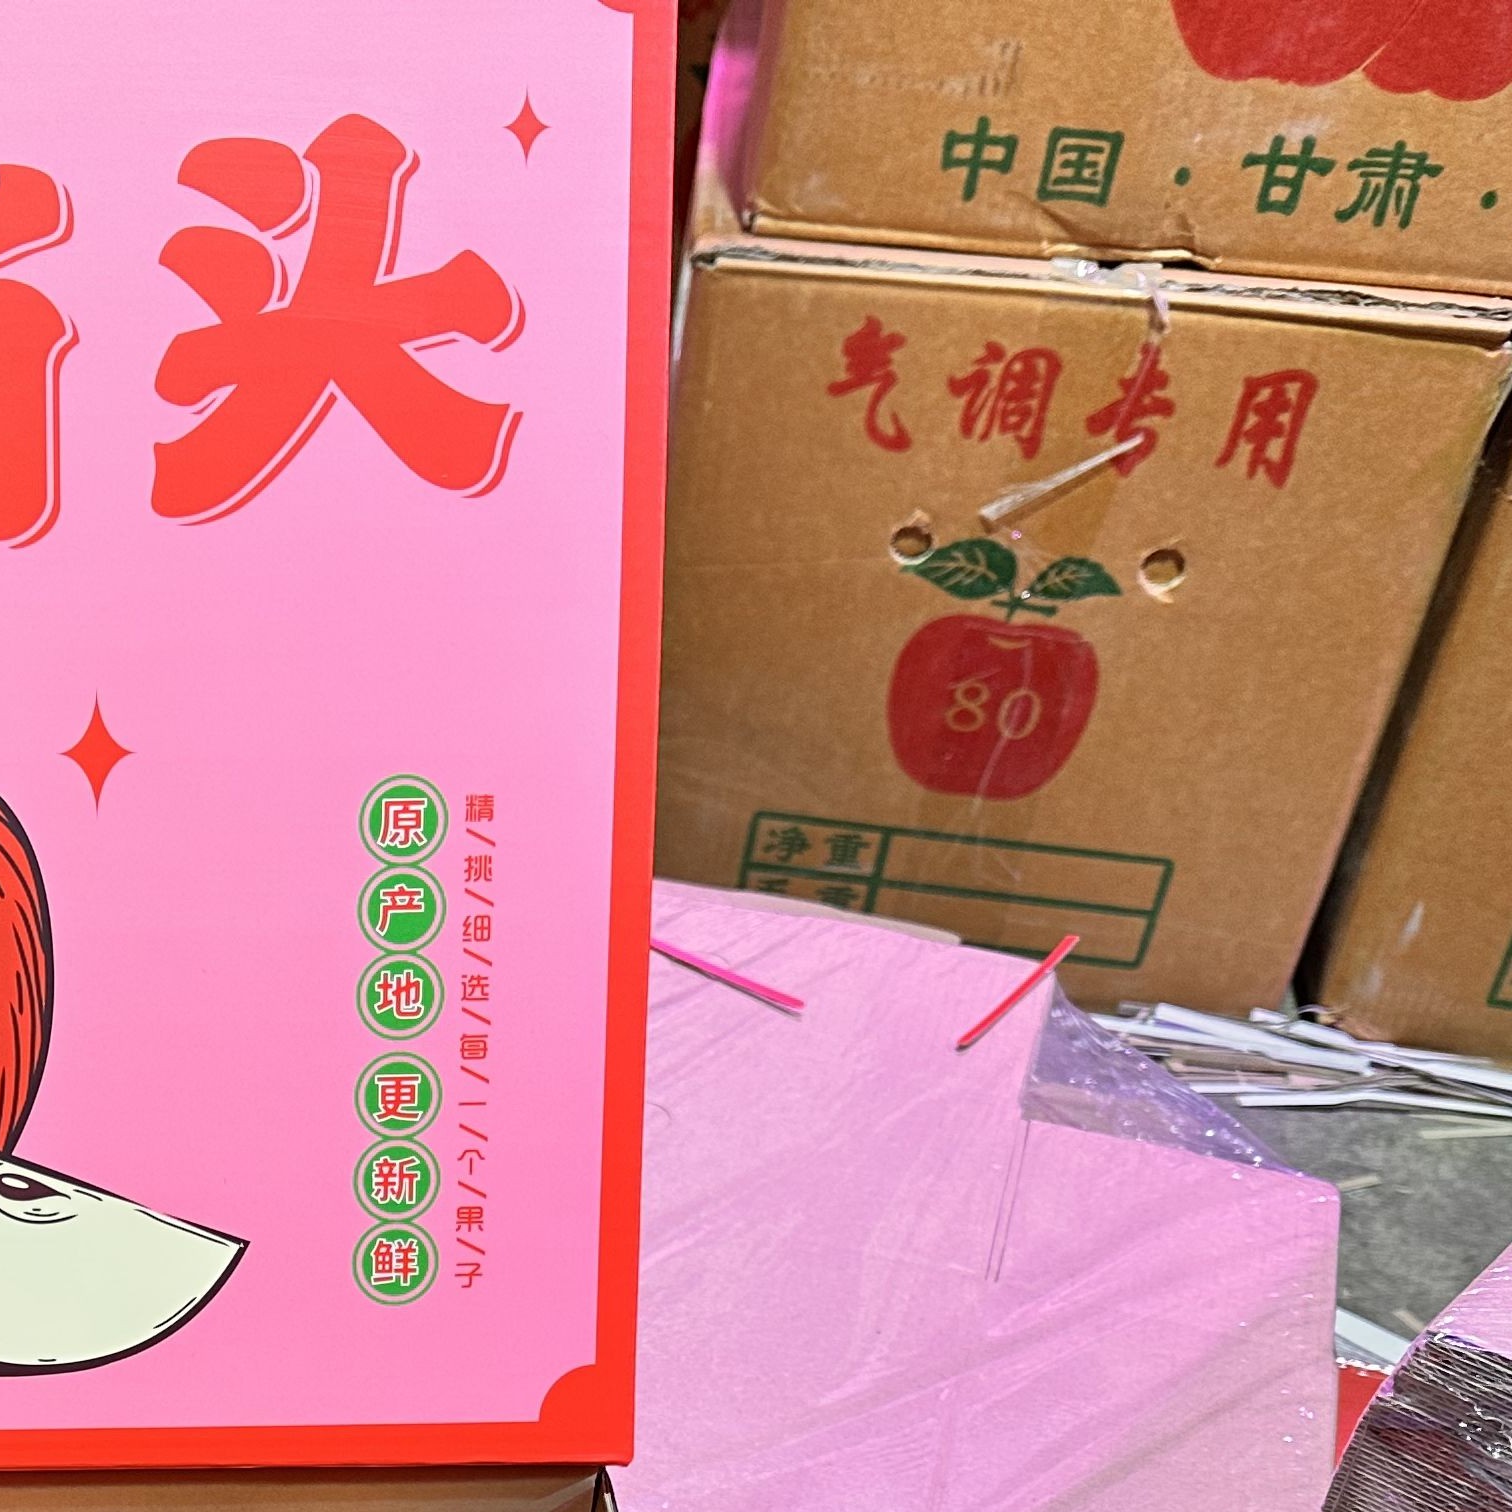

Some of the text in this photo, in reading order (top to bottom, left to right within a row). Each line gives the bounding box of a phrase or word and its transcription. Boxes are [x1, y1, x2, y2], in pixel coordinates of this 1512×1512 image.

[827, 314, 1320, 490] 气调专用
[942, 679, 1043, 741] 80
